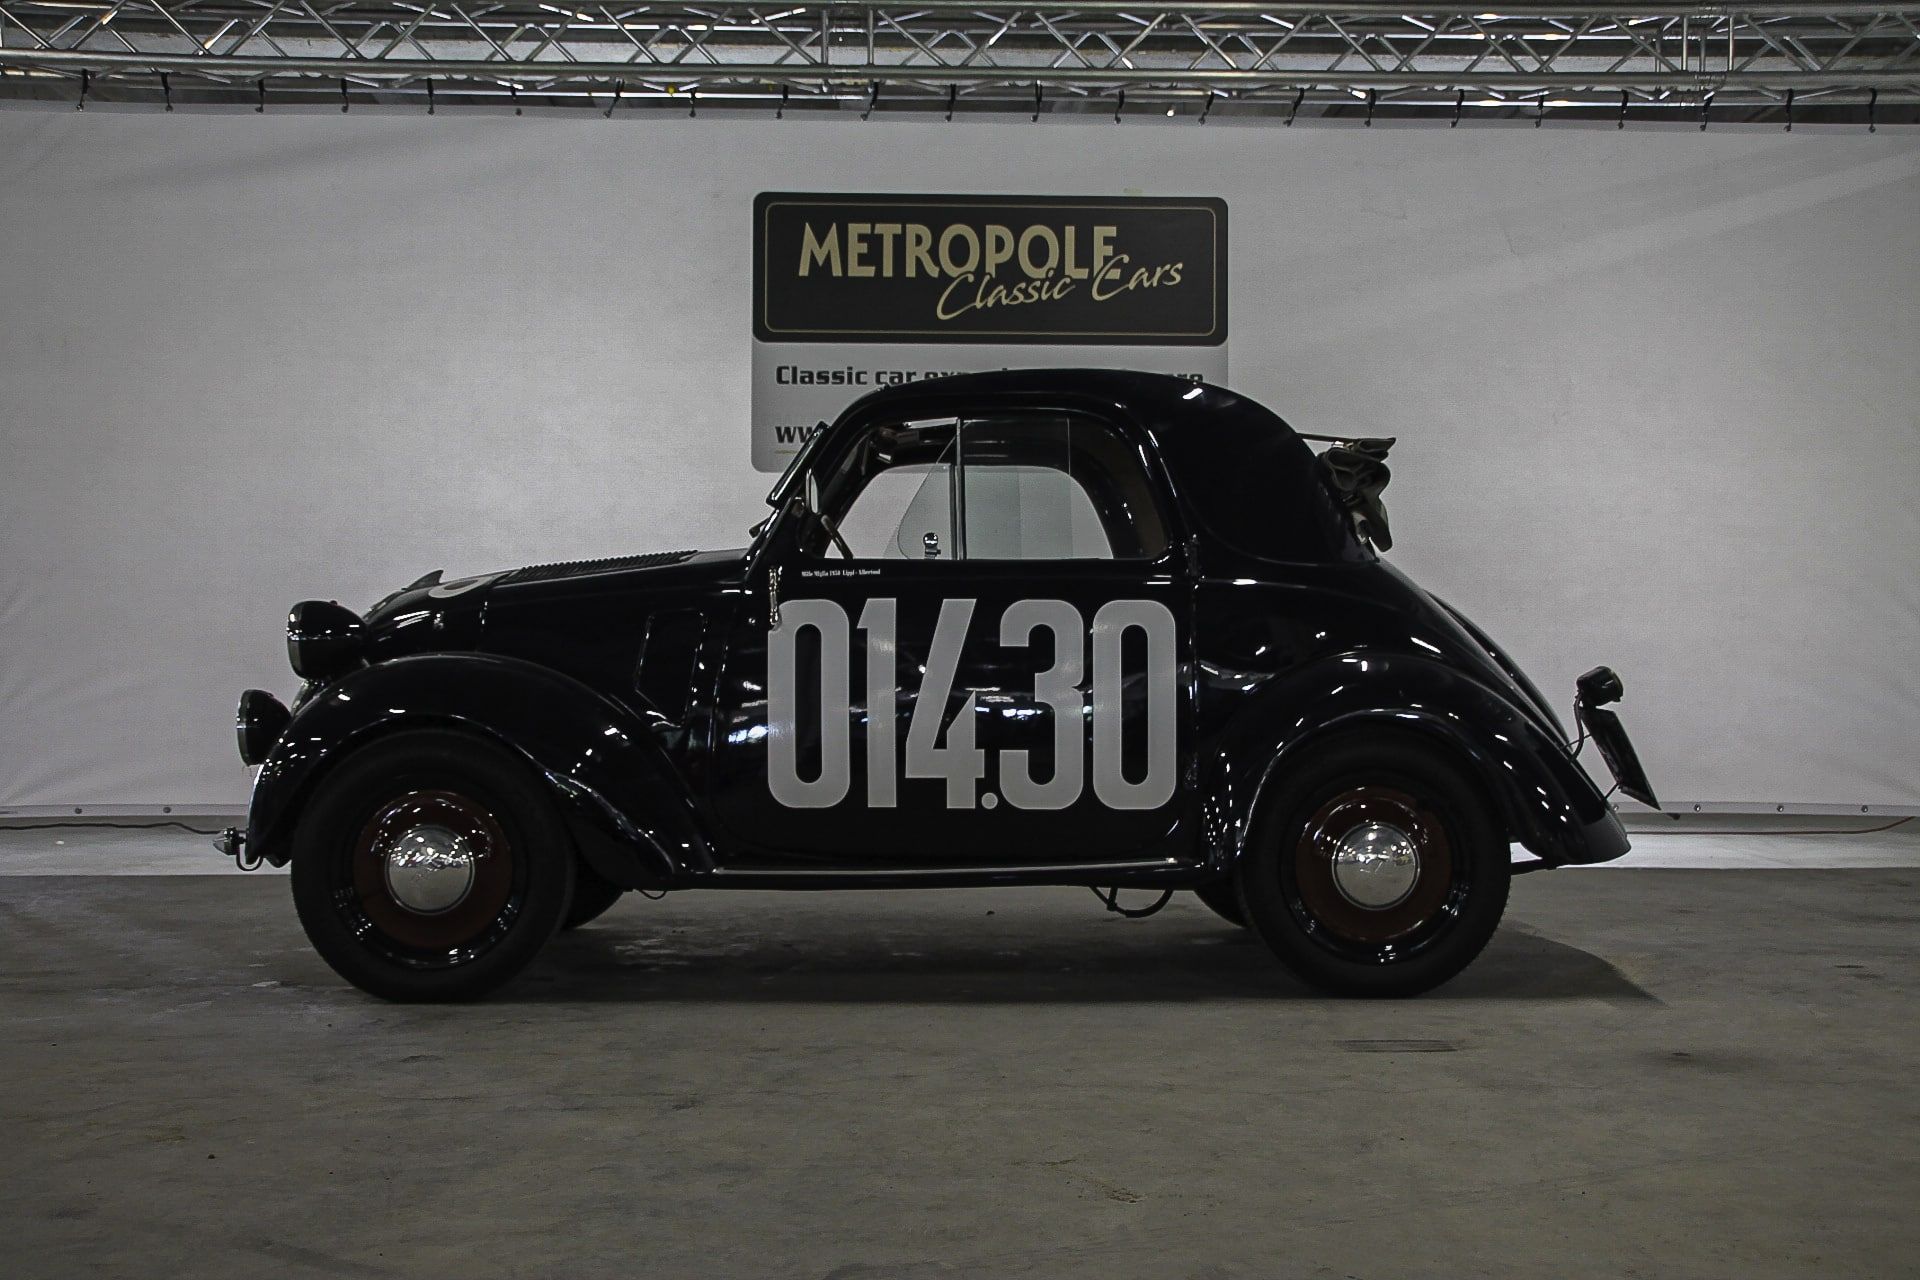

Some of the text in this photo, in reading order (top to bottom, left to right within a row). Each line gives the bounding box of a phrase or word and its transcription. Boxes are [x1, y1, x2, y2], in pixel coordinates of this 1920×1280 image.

[798, 222, 1121, 280] METROPOLE
[936, 253, 1184, 321] Classic Cars
[775, 365, 868, 386] Classic
[874, 370, 917, 386] car
[767, 597, 1177, 810] 014.30
